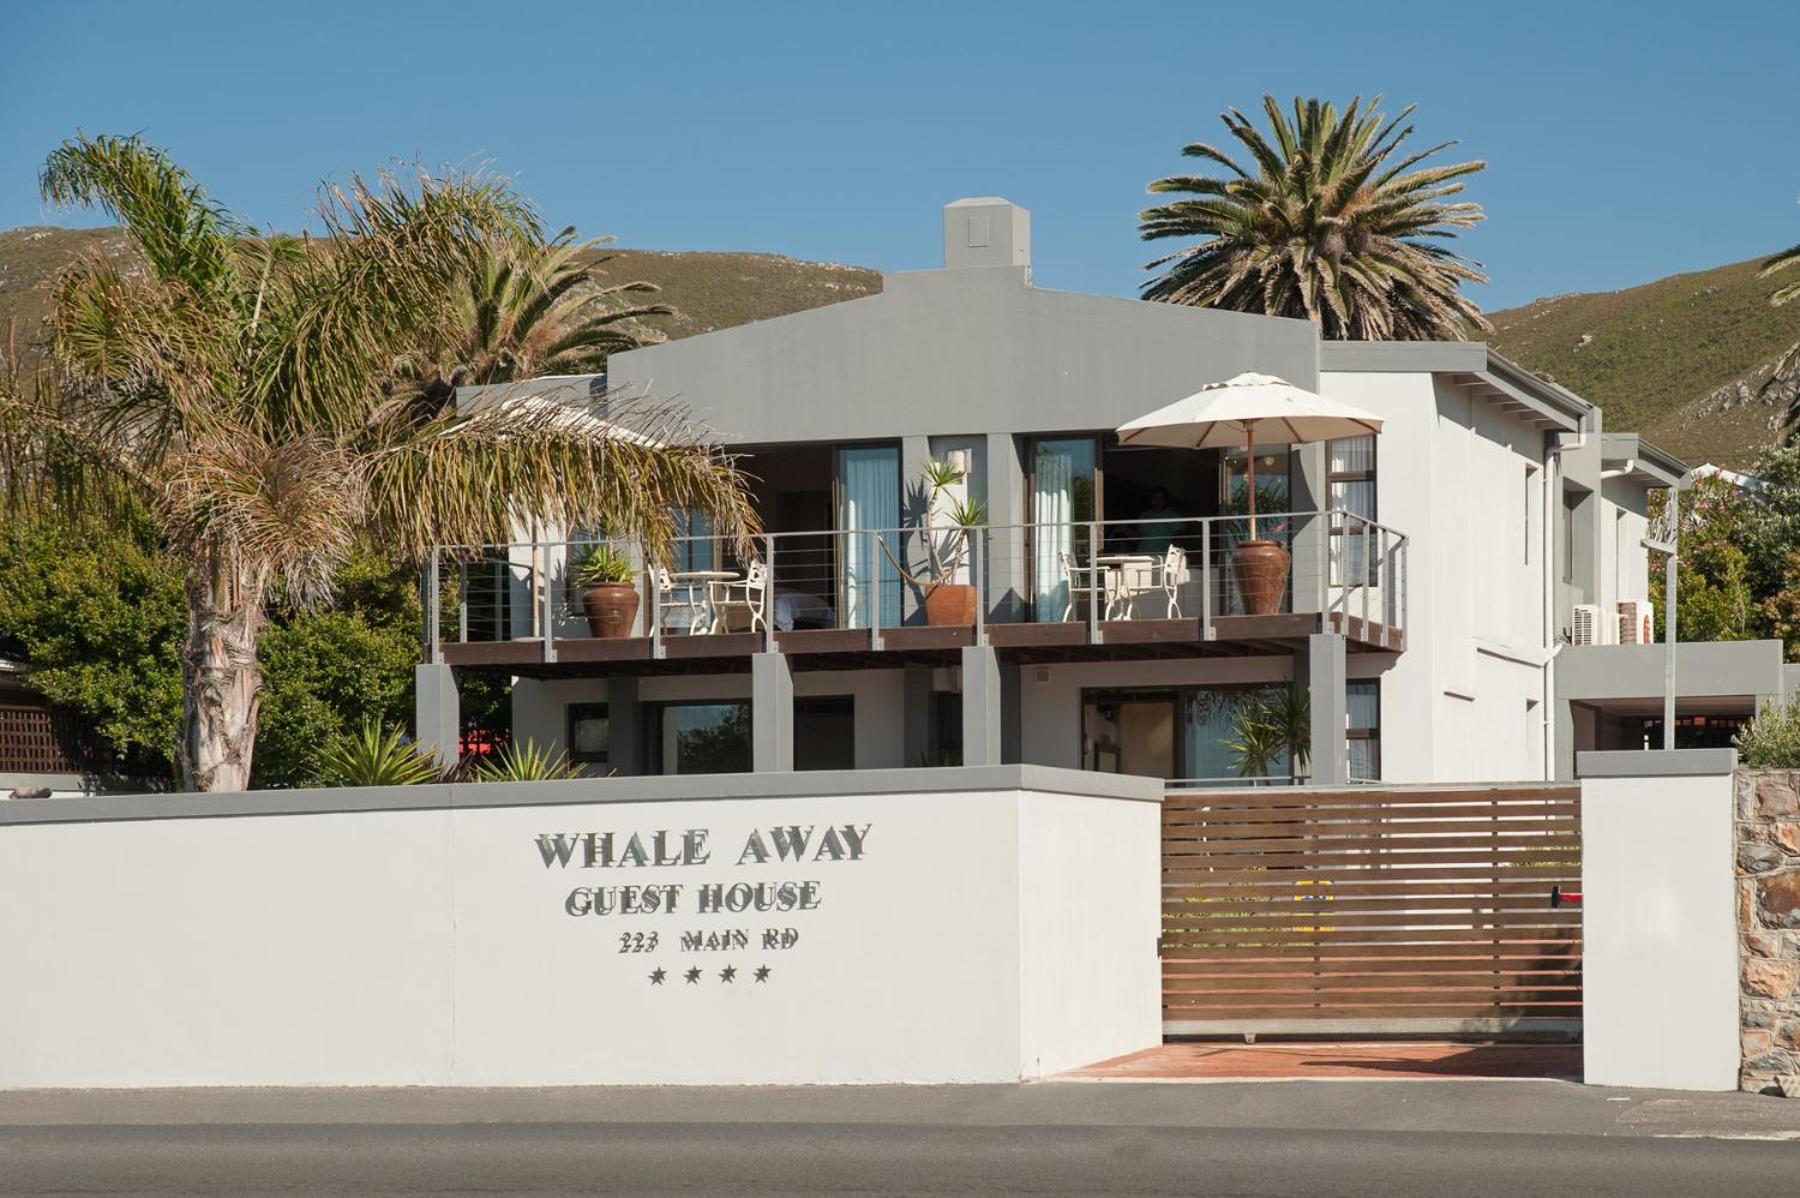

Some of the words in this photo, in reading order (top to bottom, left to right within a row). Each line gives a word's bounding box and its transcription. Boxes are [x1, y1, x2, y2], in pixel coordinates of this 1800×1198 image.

[534, 828, 711, 869] WHALE
[736, 824, 872, 866] AWAY
[565, 884, 684, 917] GUEST
[696, 880, 822, 914] HOUSE
[617, 931, 659, 953] 223
[680, 928, 749, 952] MAIN
[761, 927, 799, 951] RD
